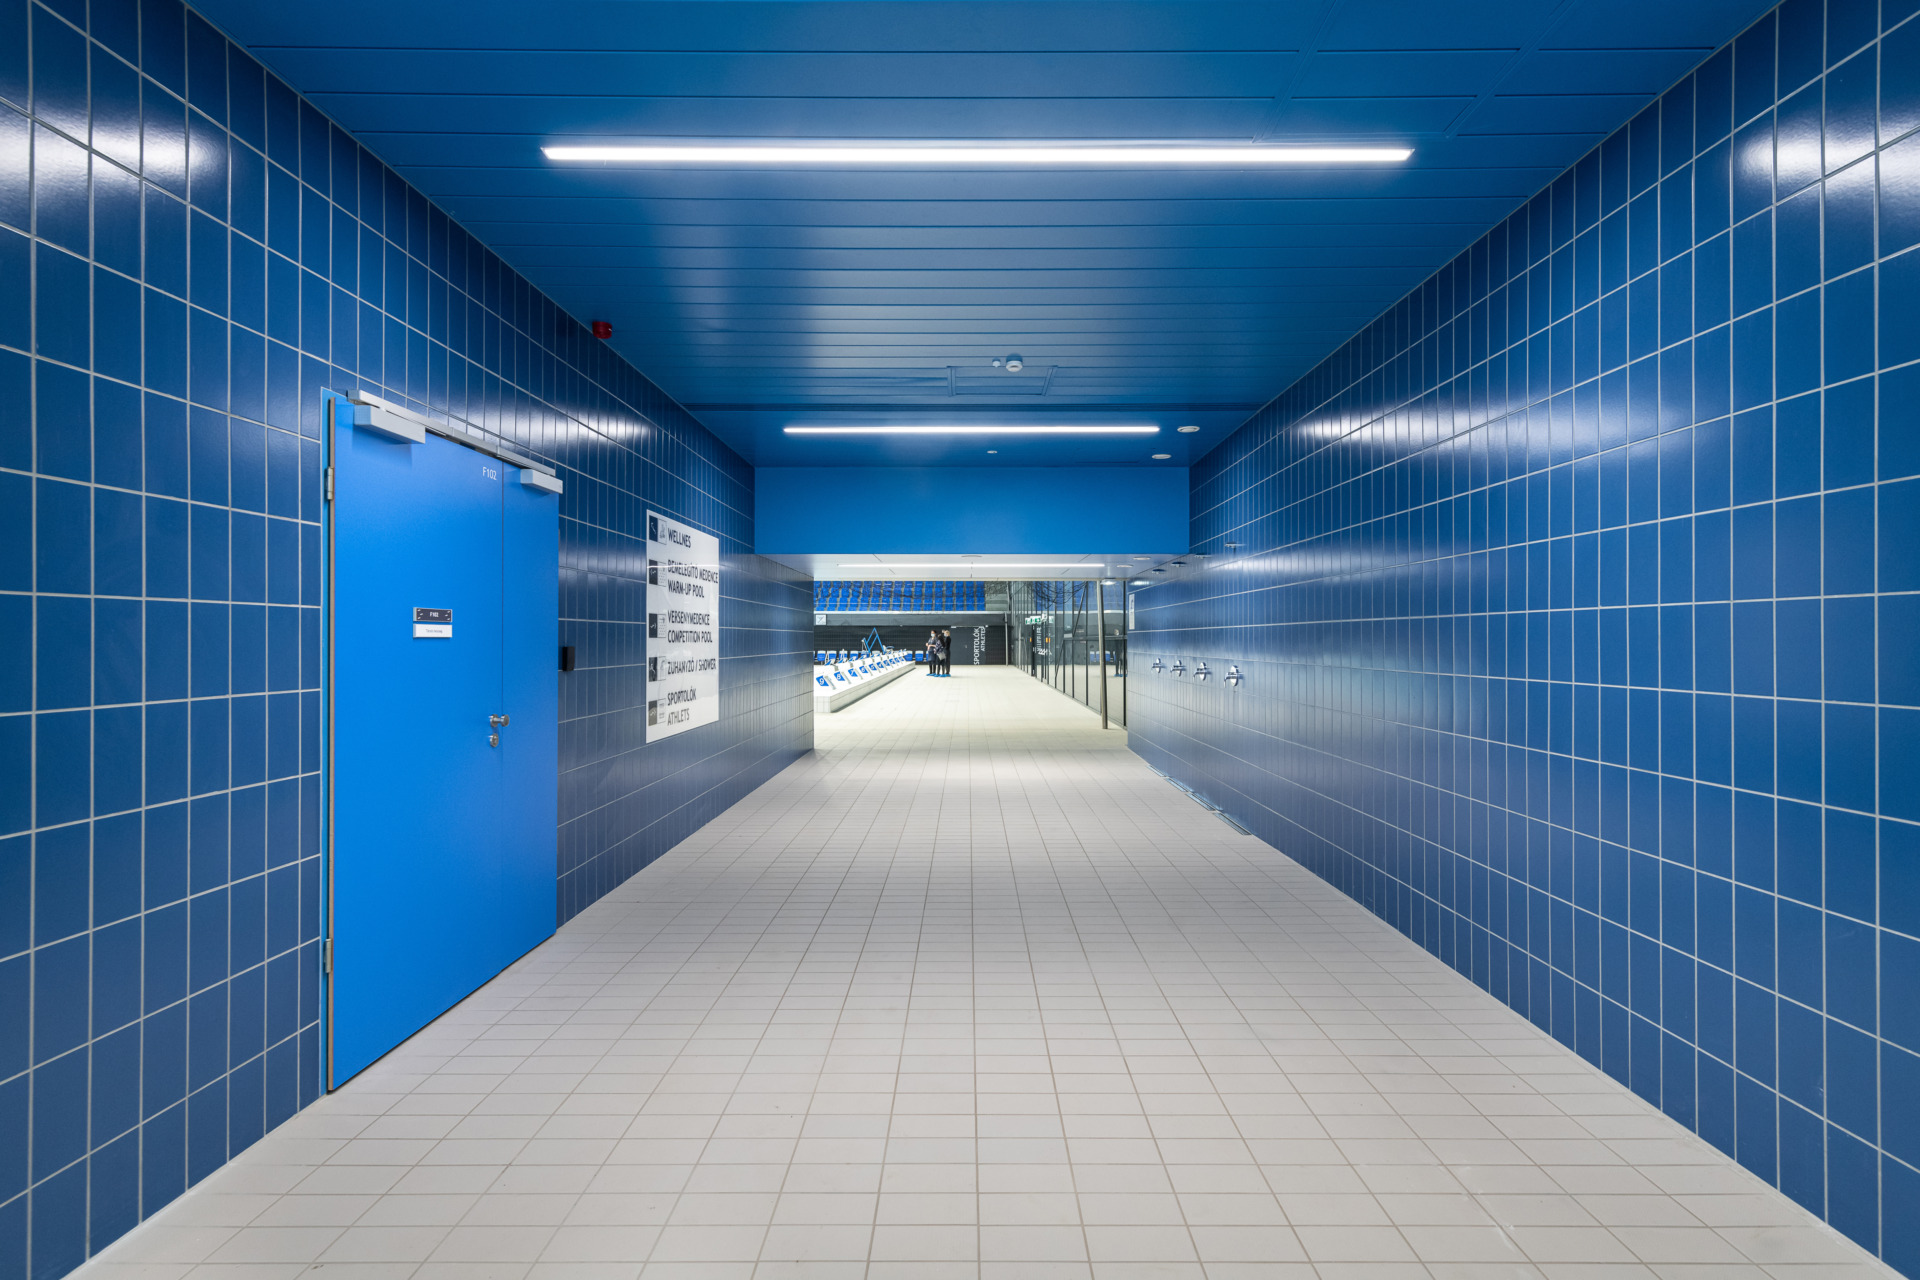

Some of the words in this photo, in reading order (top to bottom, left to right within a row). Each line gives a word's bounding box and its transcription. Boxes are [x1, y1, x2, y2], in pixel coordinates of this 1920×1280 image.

[482, 466, 497, 480] F102
[668, 528, 691, 548] WELLNES
[699, 567, 718, 584] MEDENCE
[668, 579, 692, 597] WARM-UP
[693, 585, 704, 598] POOL
[668, 610, 710, 626] VERSENYMEDENCE
[668, 630, 700, 643] COMPETITION
[701, 631, 712, 643] POOL
[668, 657, 694, 675] ZUHANYZÓ
[699, 658, 716, 671] SHOWER
[668, 686, 696, 706] SPORTOLÓK
[668, 708, 690, 726] ATHLETS
